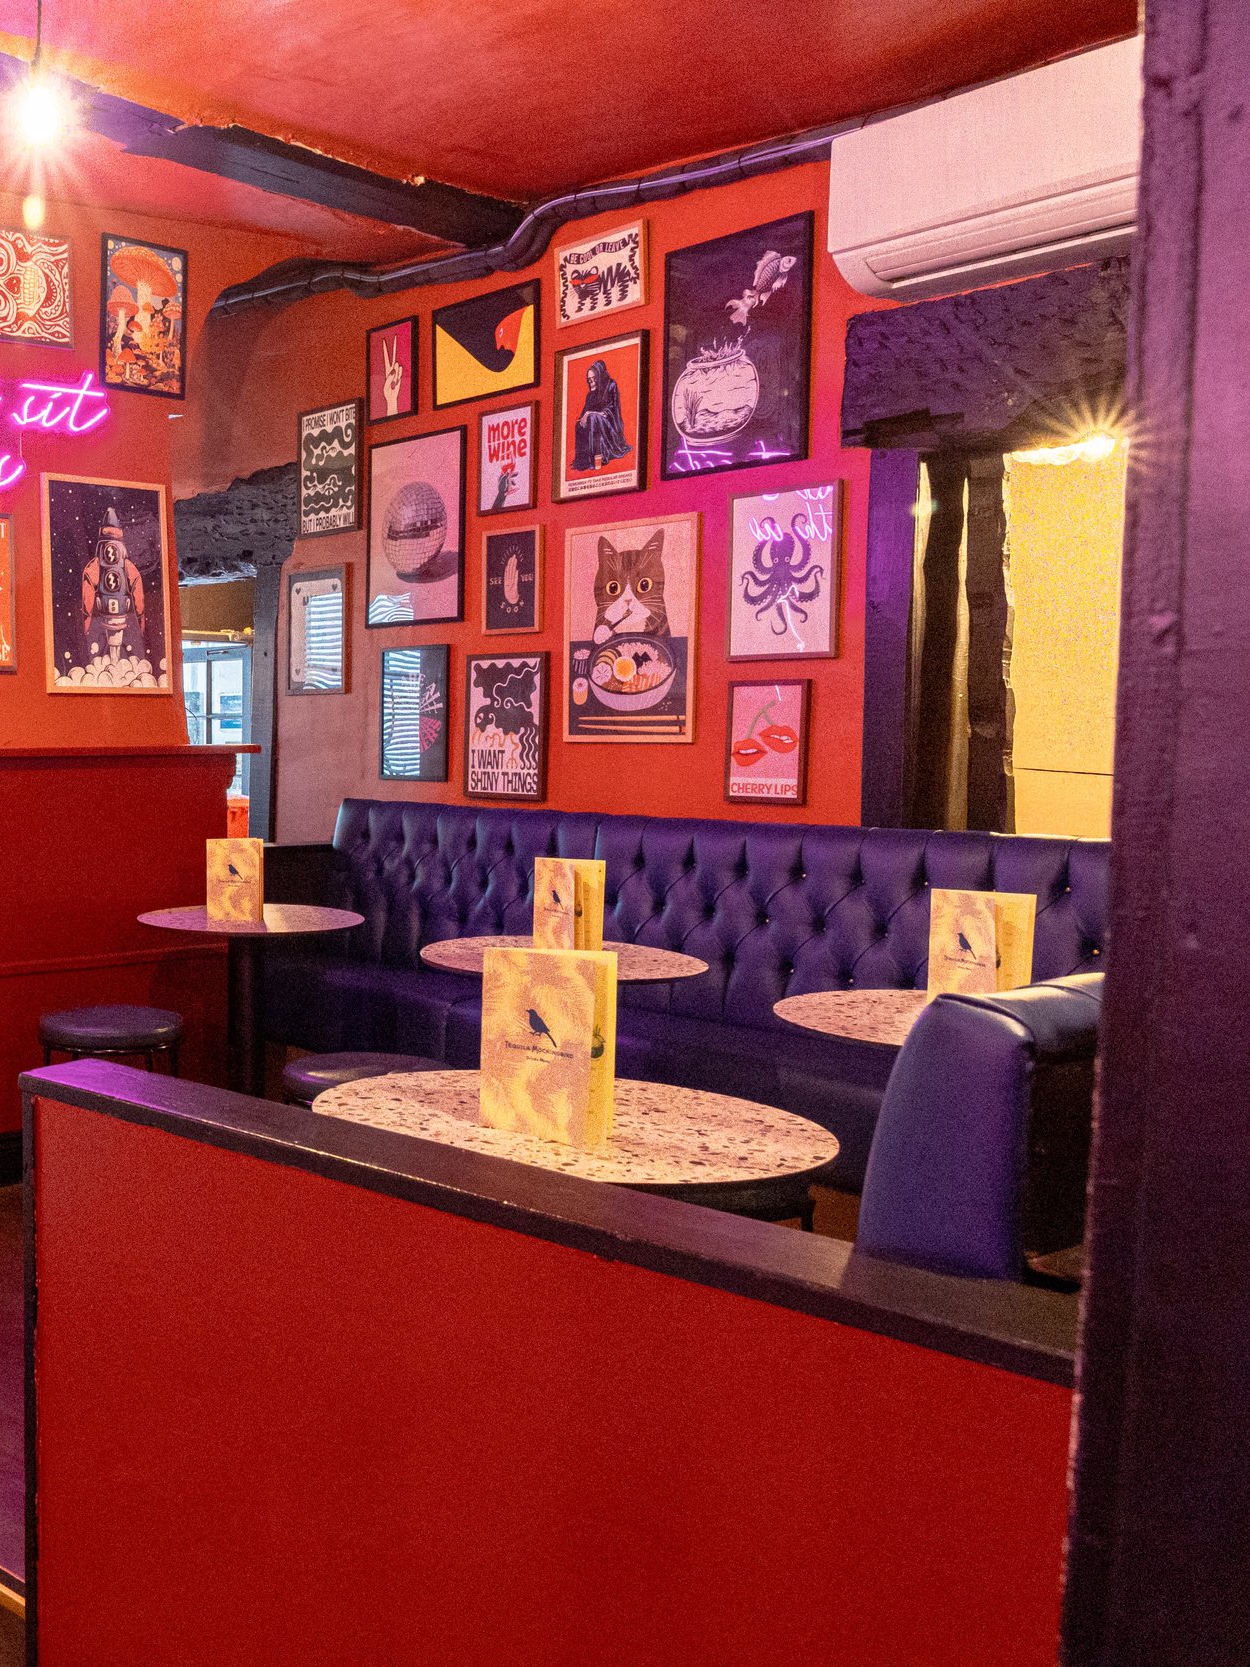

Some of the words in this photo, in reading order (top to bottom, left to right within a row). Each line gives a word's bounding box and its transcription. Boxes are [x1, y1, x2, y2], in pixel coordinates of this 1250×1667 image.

[570, 254, 578, 264] BE
[579, 250, 595, 263] COOL
[595, 243, 604, 253] OR
[605, 240, 625, 252] LEAVE
[13, 373, 109, 432] sit
[488, 417, 527, 443] more
[488, 438, 527, 463] wine
[303, 518, 312, 533] BUT
[316, 513, 342, 530] PROBABLY
[489, 577, 502, 585] SEE
[520, 573, 533, 582] YOU
[471, 749, 475, 769] I
[477, 749, 505, 769] WANT
[470, 771, 499, 791] SHINY
[501, 772, 538, 794] THINGS
[730, 782, 772, 795] CHERRY
[774, 783, 797, 796] LIPS
